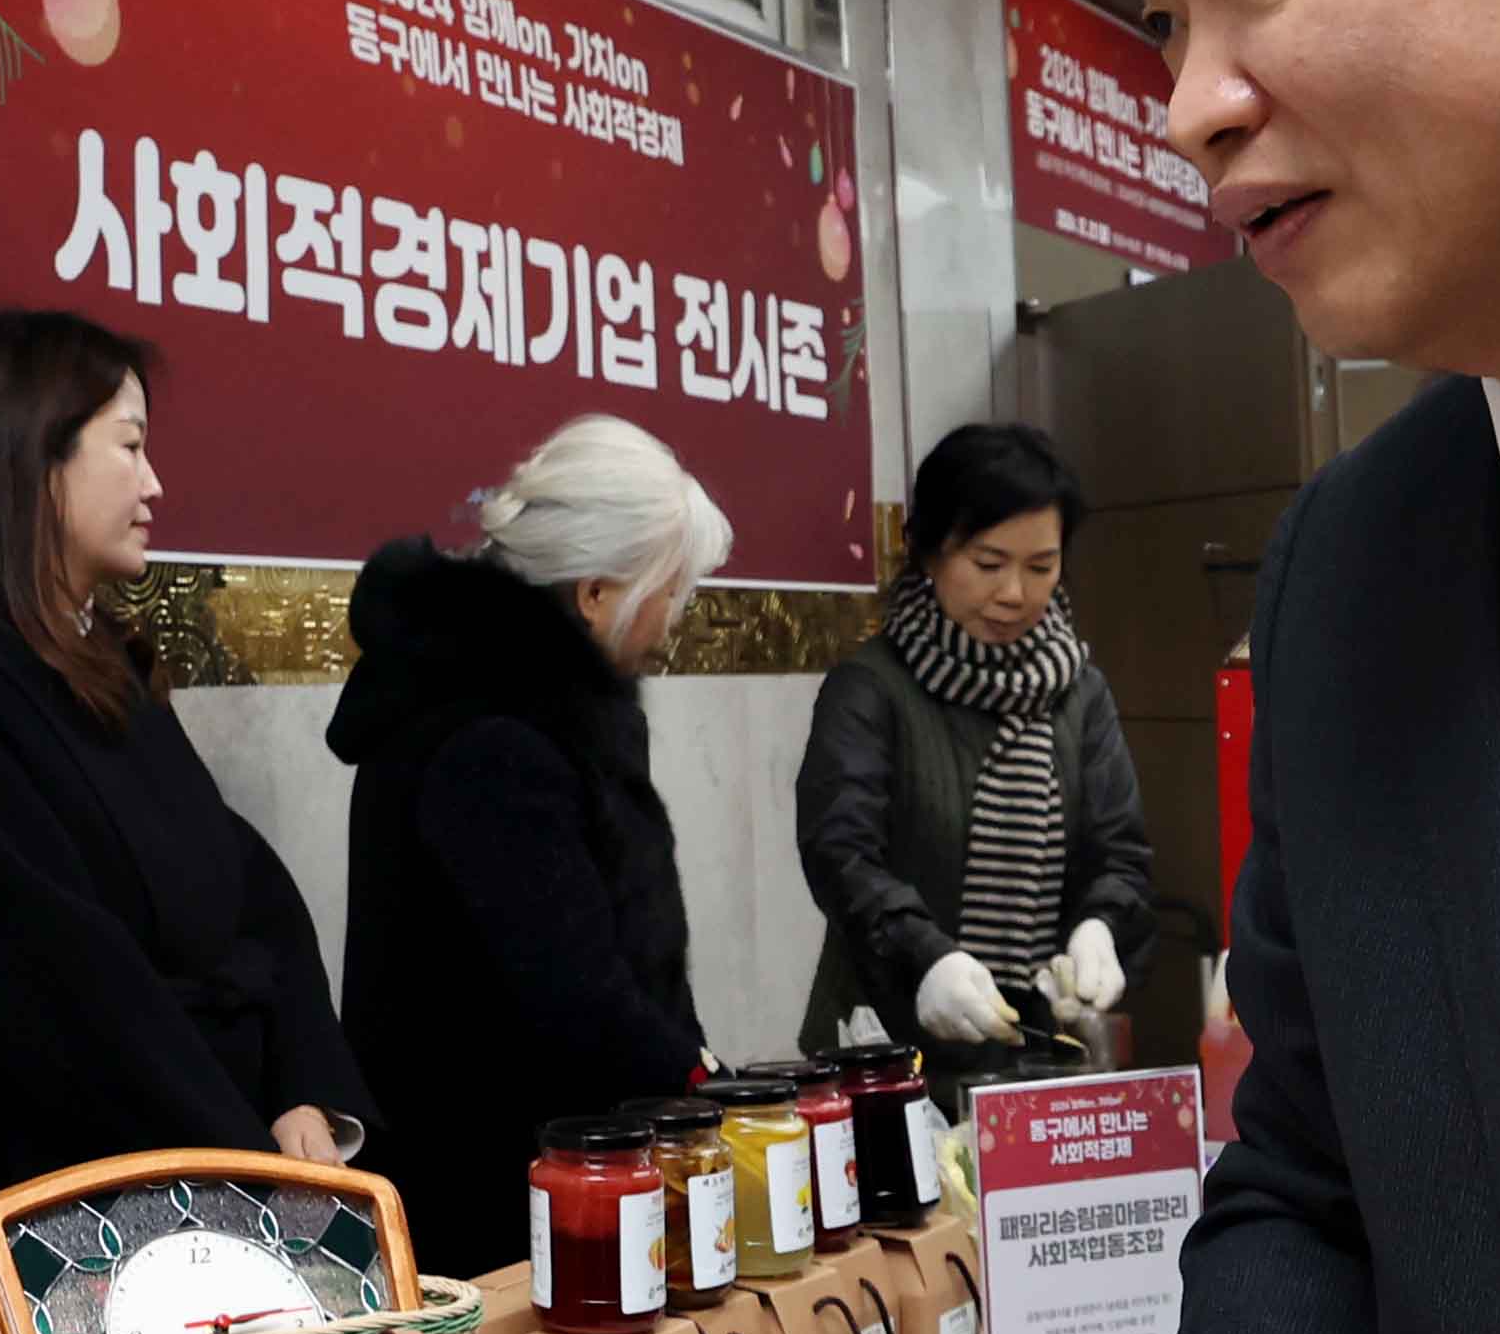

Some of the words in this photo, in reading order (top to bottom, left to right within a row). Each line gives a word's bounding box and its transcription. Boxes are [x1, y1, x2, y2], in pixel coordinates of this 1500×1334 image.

[565, 22, 649, 97] 가치on
[346, 1, 471, 95] 동구에서
[475, 49, 558, 124] 만나는
[563, 82, 684, 166] 사회적경제
[55, 127, 658, 390] 사회적경제기업
[673, 273, 829, 420] 전시존
[1030, 1114, 1096, 1142] 동구에서
[1100, 1110, 1148, 1134] 만나는
[1051, 1136, 1132, 1165] 사회적경제
[189, 1247, 212, 1264] 12
[1028, 1228, 1164, 1268] 사회적협동조합
